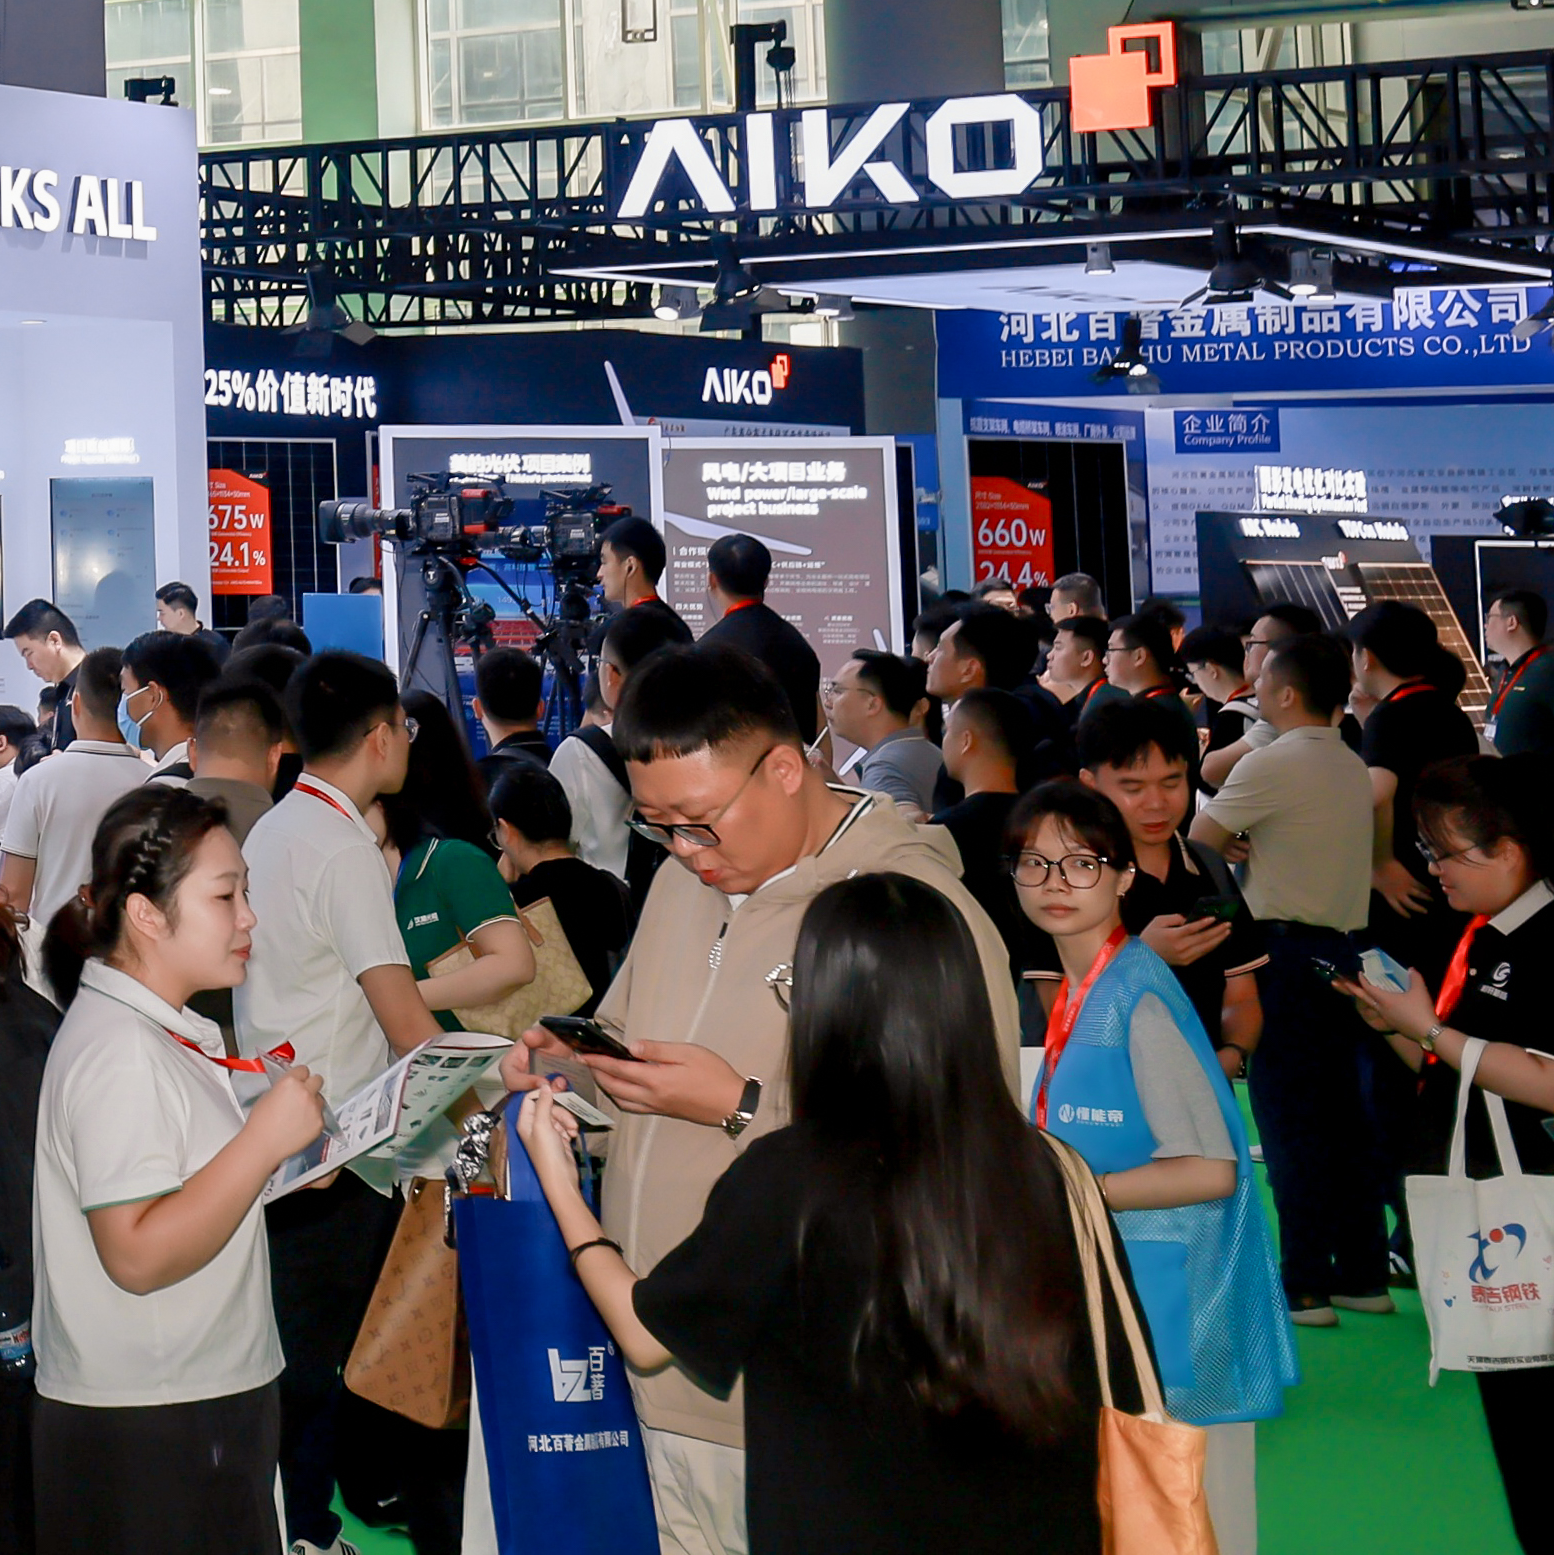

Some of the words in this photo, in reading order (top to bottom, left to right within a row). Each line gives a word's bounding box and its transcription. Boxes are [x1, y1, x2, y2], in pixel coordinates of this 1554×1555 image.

[616, 93, 1043, 219] AIKO
[68, 174, 157, 243] ALL
[1000, 347, 1074, 368] HEBEI
[1082, 344, 1173, 366] BAHU
[1182, 341, 1266, 363] METAL
[1273, 336, 1415, 360] PRODUCTS
[203, 368, 378, 419] 25%价值新时代
[702, 366, 773, 406] AIKO
[1182, 412, 1272, 435] 企业简介
[1183, 434, 1235, 447] Company
[1237, 433, 1272, 446] Profile
[701, 460, 847, 483] 风电/大项目业务
[706, 485, 742, 501] Wind
[744, 484, 869, 502] power/large-scale
[706, 501, 757, 519] project
[758, 501, 820, 516] business
